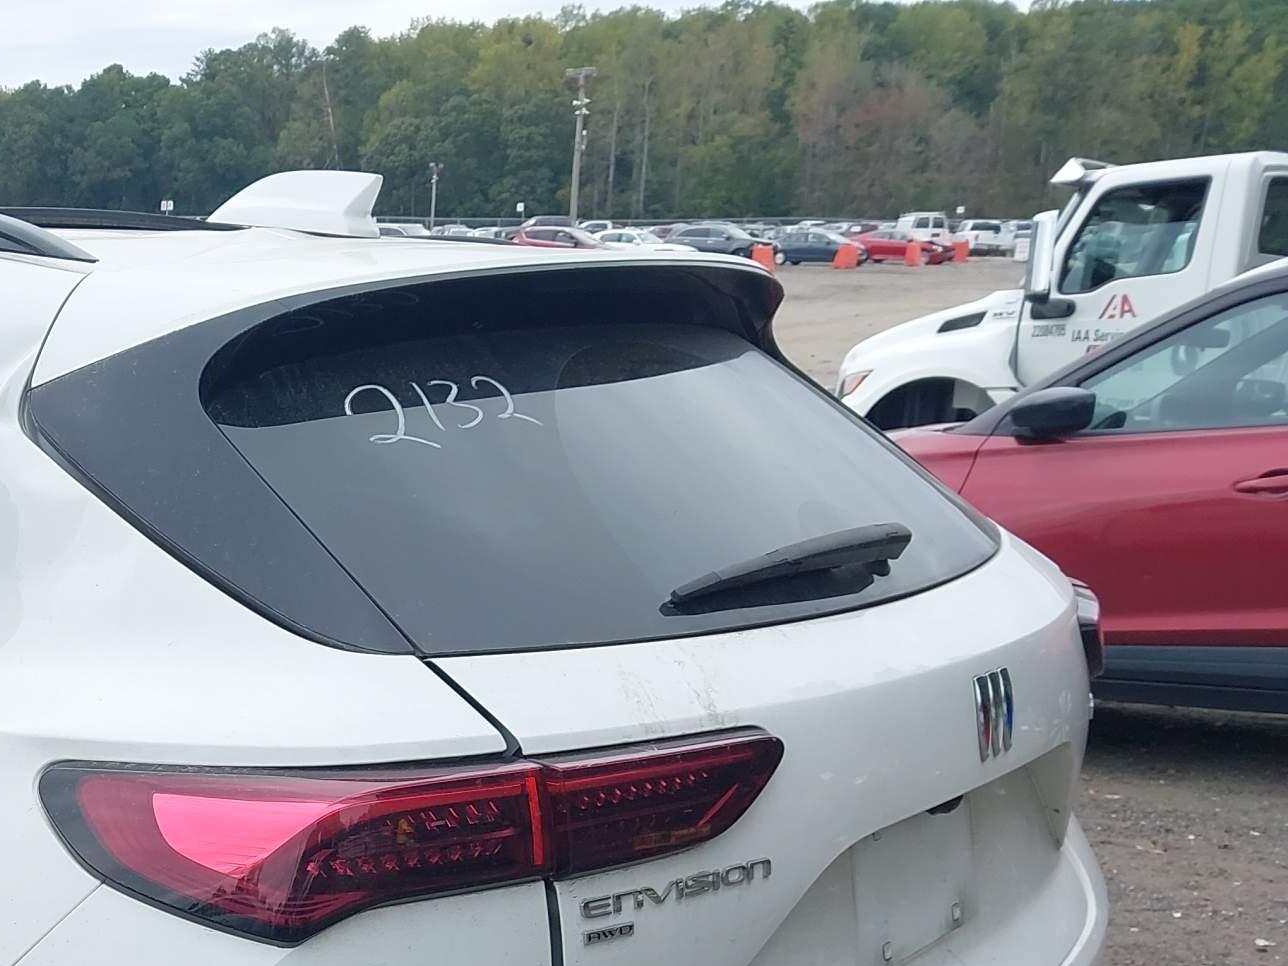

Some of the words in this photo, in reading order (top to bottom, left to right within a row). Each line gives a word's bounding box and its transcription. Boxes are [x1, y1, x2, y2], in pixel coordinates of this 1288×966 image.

[343, 375, 544, 449] 2132
[579, 855, 773, 919] ENVISION
[586, 923, 634, 943] AWD
